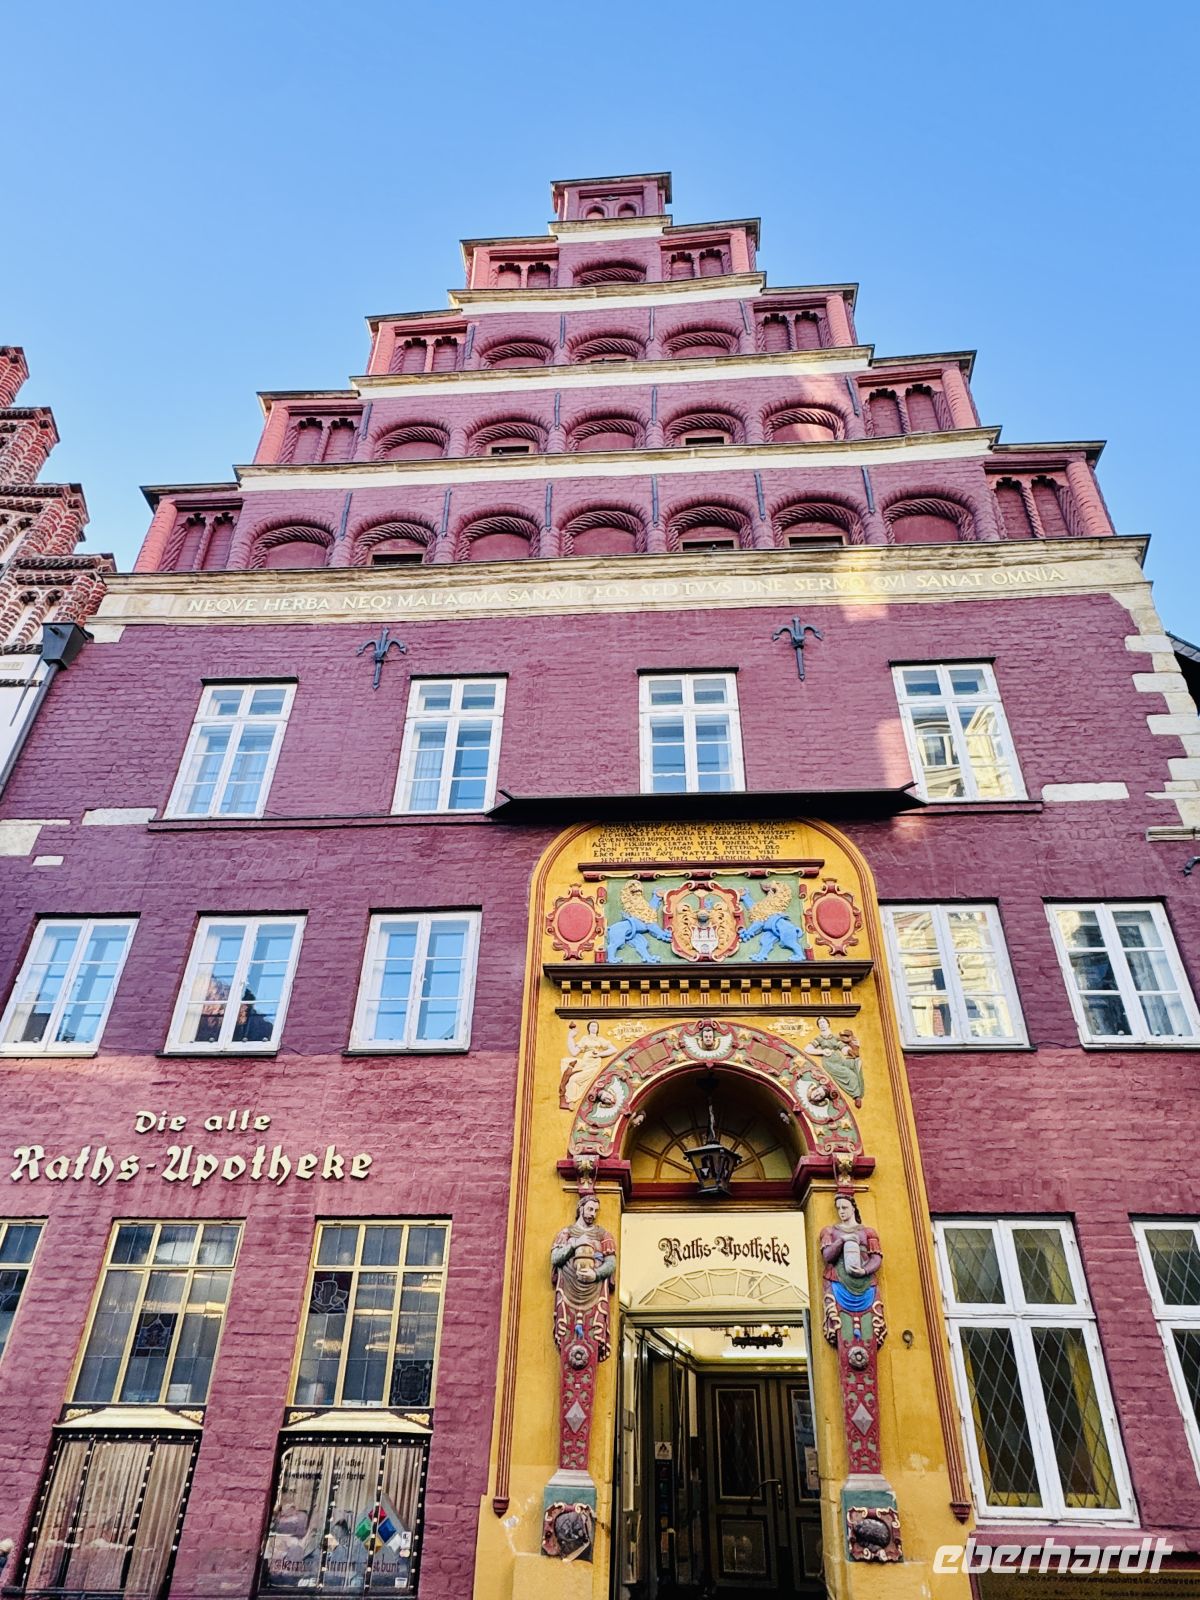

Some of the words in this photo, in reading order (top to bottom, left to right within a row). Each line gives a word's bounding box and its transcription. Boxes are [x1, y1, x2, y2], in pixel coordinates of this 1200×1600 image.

[187, 598, 258, 613] NEQVE
[263, 597, 331, 611] HERBA
[507, 587, 583, 603] SANAVIT
[872, 573, 906, 590] QVI
[915, 573, 984, 588] SANAT
[991, 567, 1067, 586] OMNIA
[134, 1109, 188, 1133] Die
[203, 1109, 272, 1132] alte
[9, 1144, 373, 1187] Raths-Apotheke
[658, 1235, 791, 1267] Raths-Apotheke
